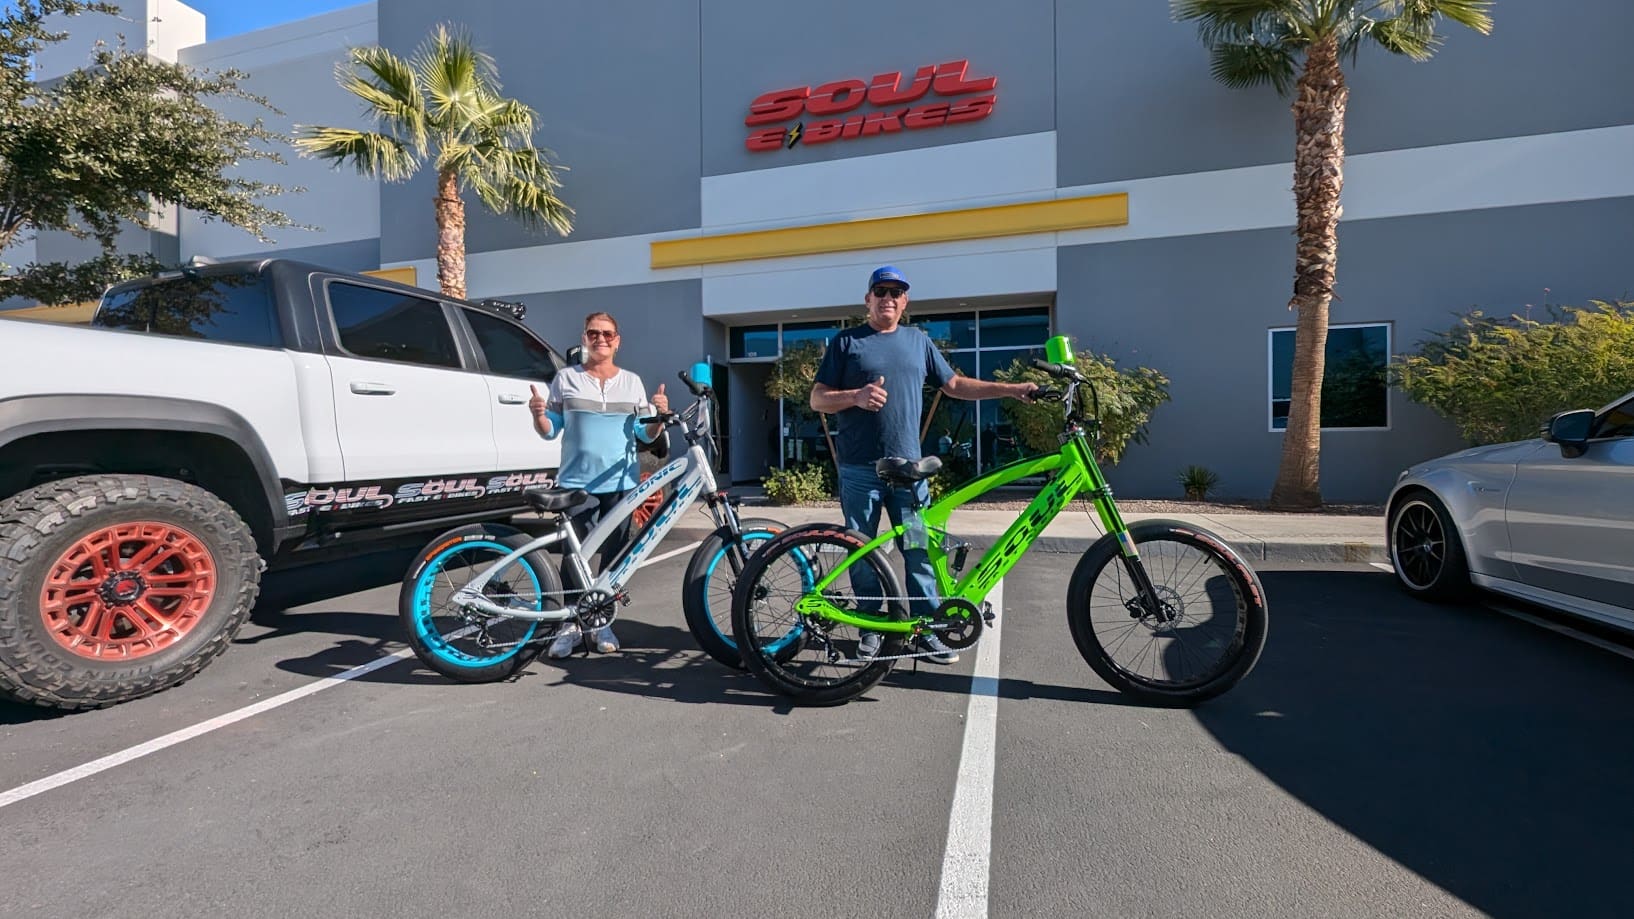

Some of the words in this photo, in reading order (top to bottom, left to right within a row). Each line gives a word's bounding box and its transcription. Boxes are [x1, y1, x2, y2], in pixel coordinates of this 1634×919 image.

[745, 59, 997, 127] SOUL
[745, 127, 787, 152] E
[803, 95, 997, 145] BIKES
[285, 486, 393, 511] SOUL
[395, 478, 486, 499] SOUL
[486, 473, 553, 490] SOUL
[627, 463, 682, 505] SONIC
[977, 472, 1083, 589] SOUL
